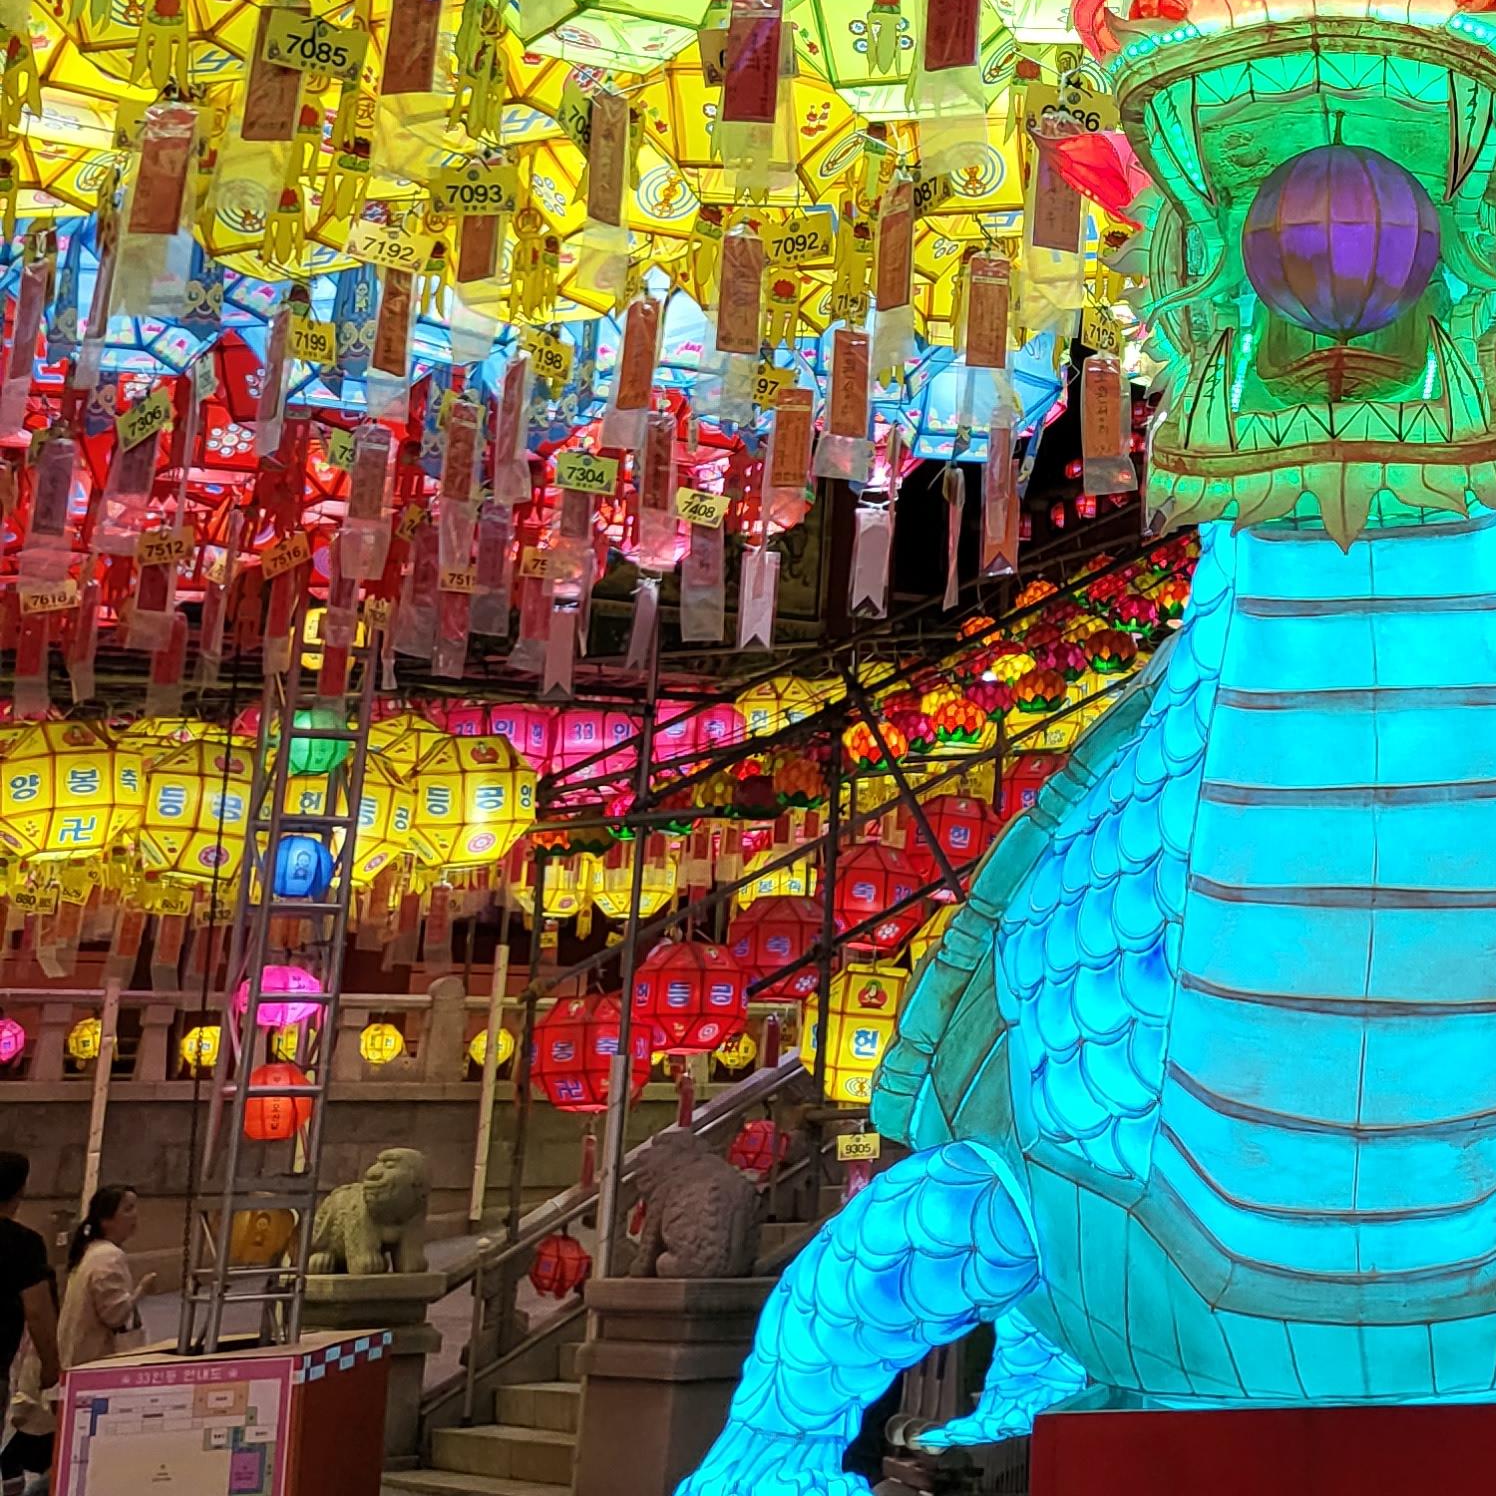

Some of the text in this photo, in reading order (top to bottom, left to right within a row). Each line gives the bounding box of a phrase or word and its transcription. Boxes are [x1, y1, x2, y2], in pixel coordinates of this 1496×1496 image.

[287, 34, 349, 66] 7085
[446, 185, 503, 204] 7093
[363, 236, 415, 262] 7192
[772, 232, 819, 258] 7092
[294, 331, 327, 352] 7199
[528, 342, 563, 370] 7198
[128, 407, 163, 436] 7306
[567, 466, 607, 485] 7304
[683, 501, 717, 519] 7408
[146, 541, 185, 559] 7512
[271, 547, 302, 569] 7516
[67, 768, 100, 795] 봉
[158, 785, 187, 817] 등
[425, 785, 451, 815] 등
[666, 980, 692, 1008] 등
[854, 1028, 881, 1058] 헌
[845, 1143, 872, 1155] 9305
